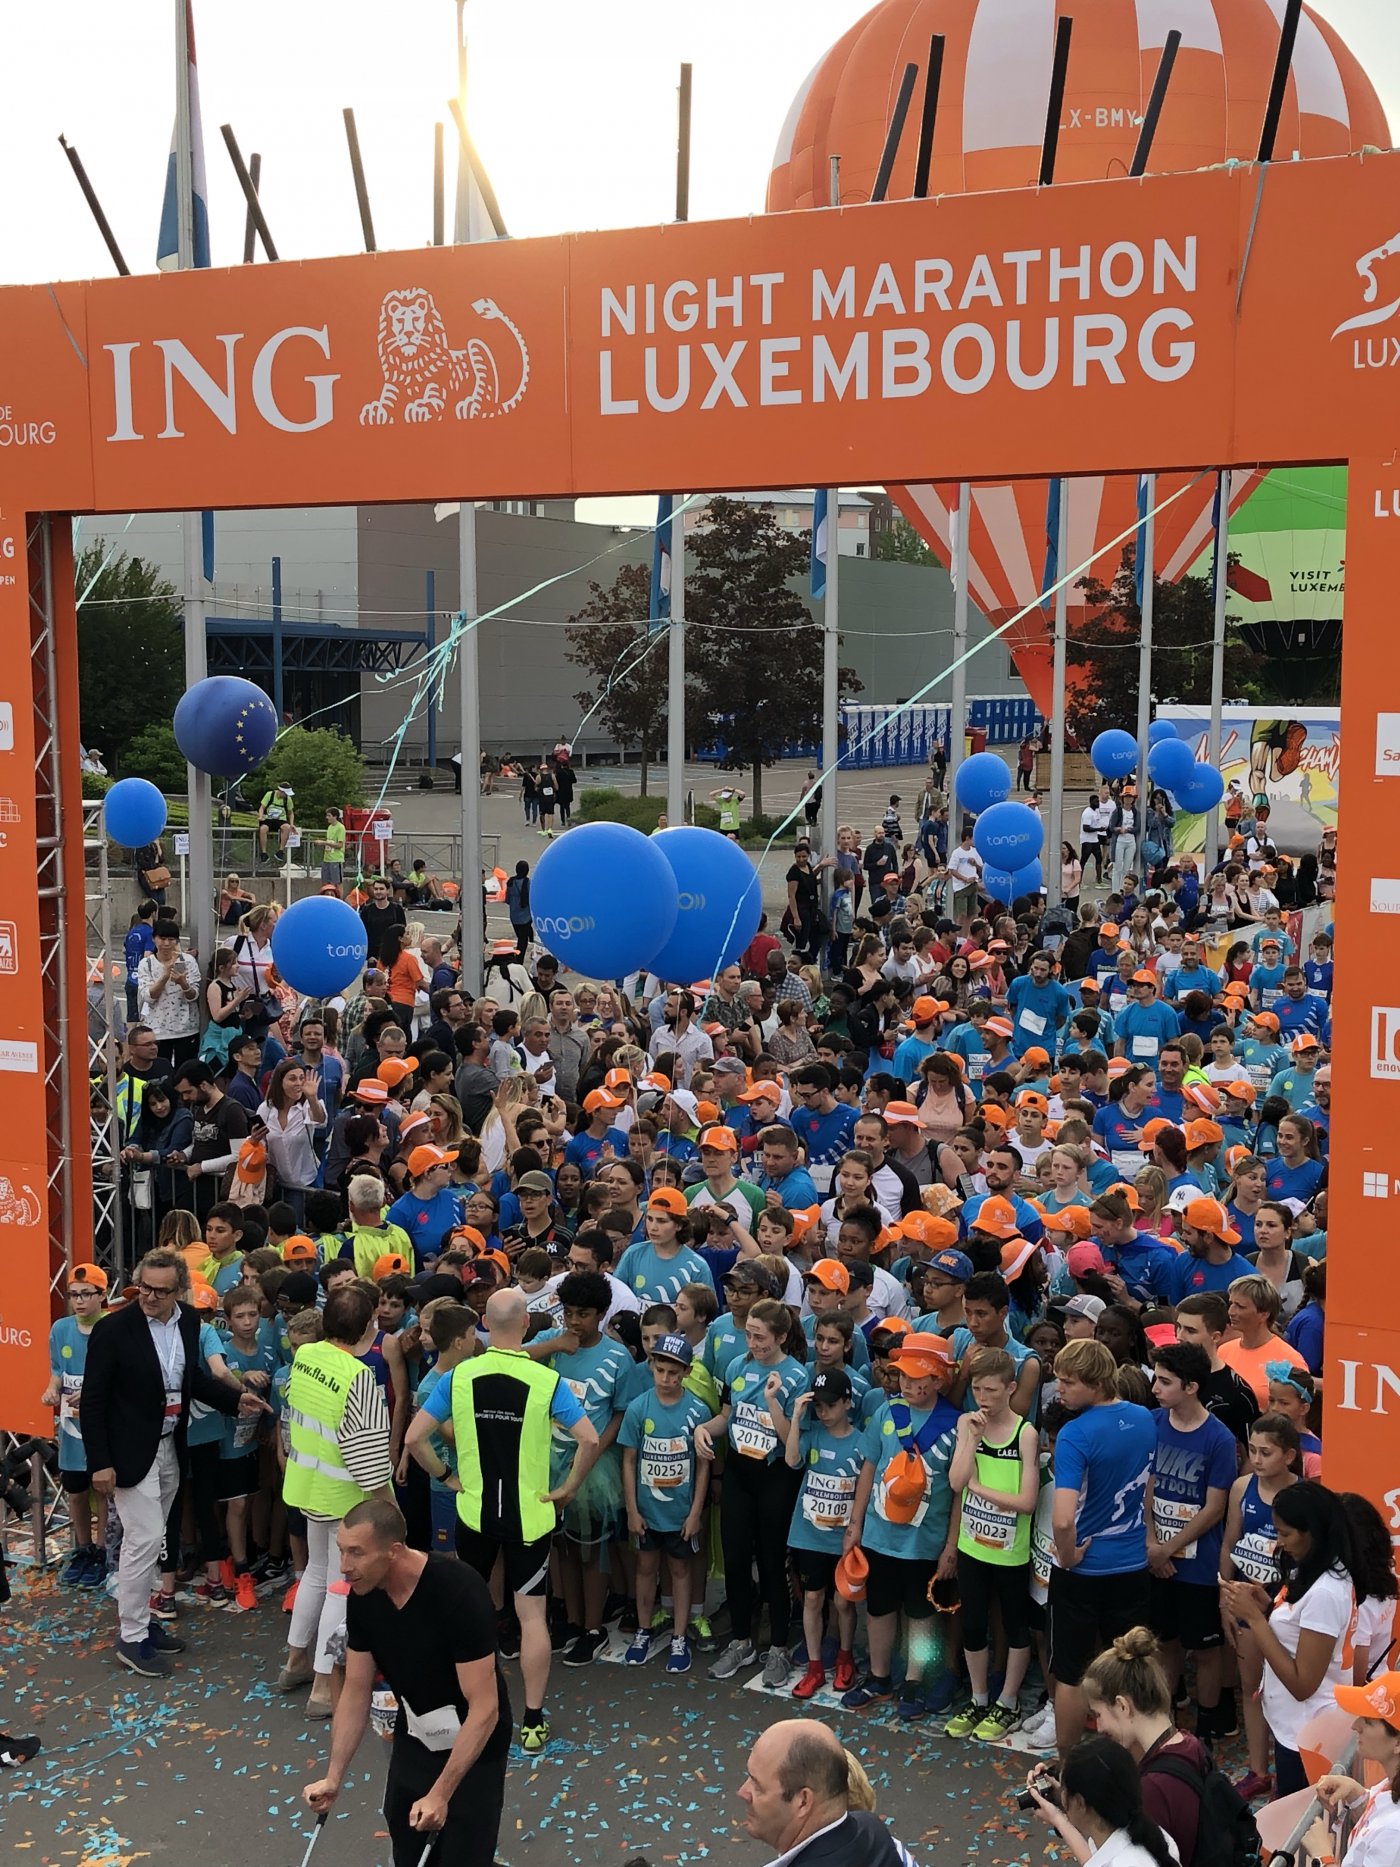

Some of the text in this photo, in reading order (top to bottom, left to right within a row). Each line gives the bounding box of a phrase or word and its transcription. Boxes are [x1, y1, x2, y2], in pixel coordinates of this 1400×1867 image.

[600, 236, 1197, 338] NIGHT MARATHON
[600, 308, 1196, 415] LUXEMBOURG
[102, 324, 341, 442] ING
[1290, 570, 1331, 580] VISIT
[645, 1439, 668, 1453] ING
[647, 1463, 684, 1477] 20252
[811, 1475, 836, 1490] ING
[810, 1499, 848, 1516] 20109
[968, 1491, 994, 1512] ING
[965, 1507, 1014, 1526] LUXEMBOURG
[969, 1518, 1008, 1539] 20023
[1034, 1558, 1049, 1577] 28
